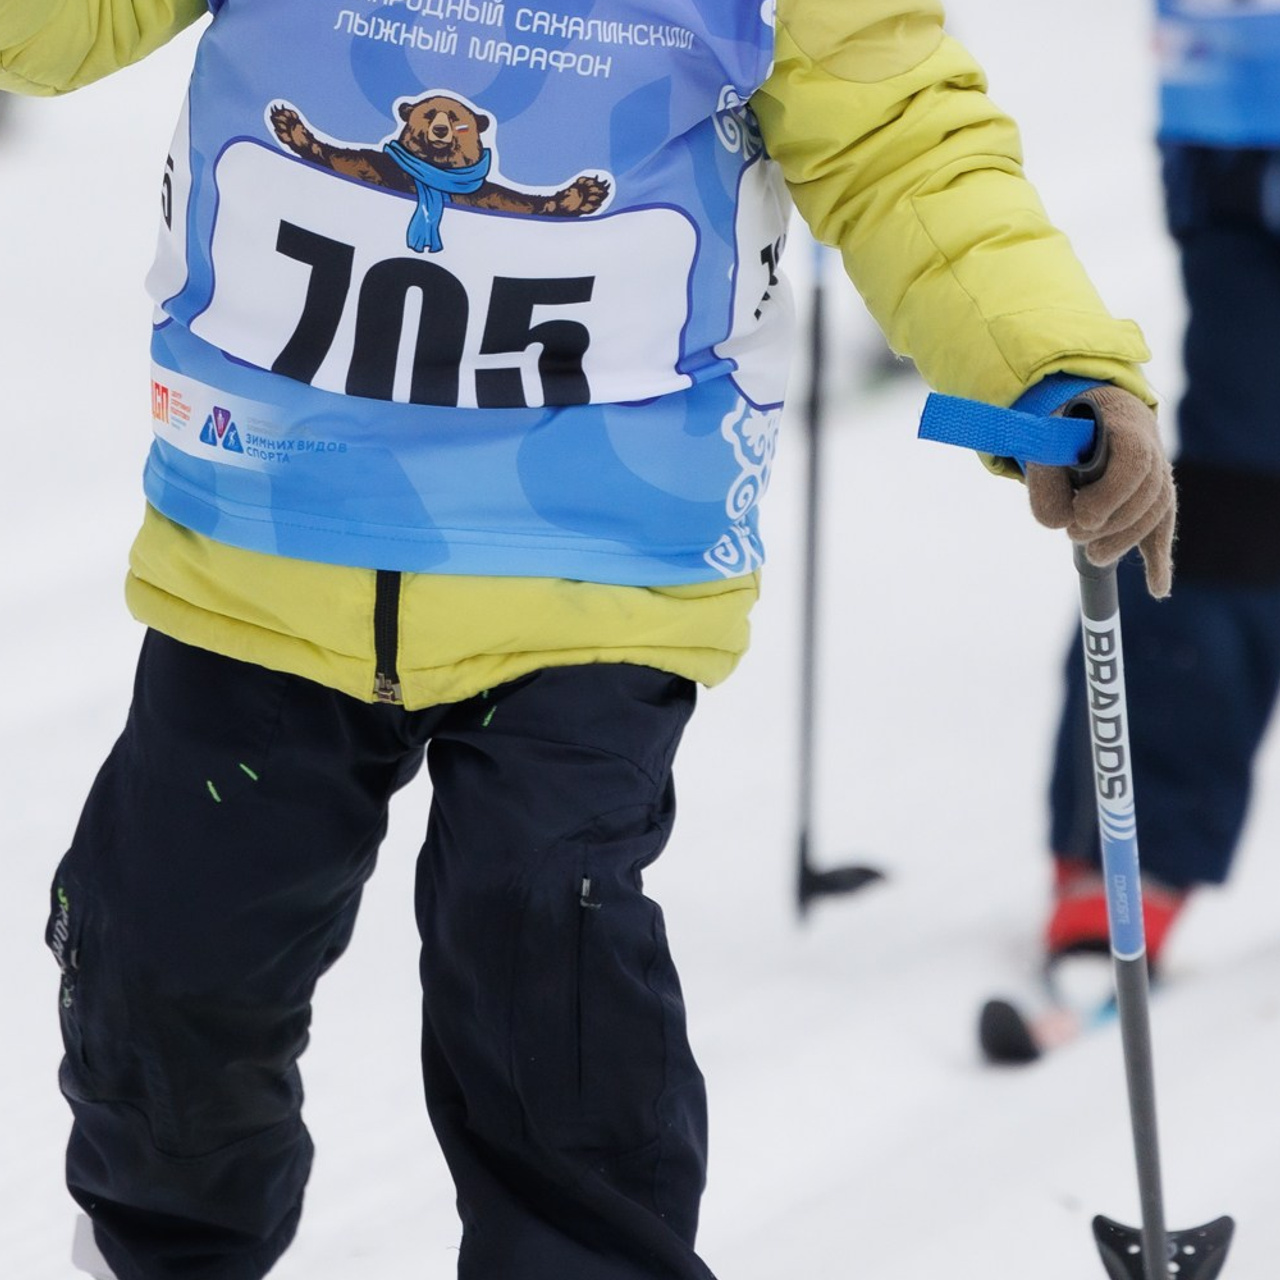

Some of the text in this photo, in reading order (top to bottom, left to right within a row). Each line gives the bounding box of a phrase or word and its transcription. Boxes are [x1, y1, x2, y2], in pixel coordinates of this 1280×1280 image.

[333, 10, 612, 79] ЛЫЖНЫЙ МАРАФОН
[271, 219, 596, 409] 705
[245, 432, 348, 454] ЗИМНИХ ВИДОВ
[245, 445, 291, 464] СПОРТА
